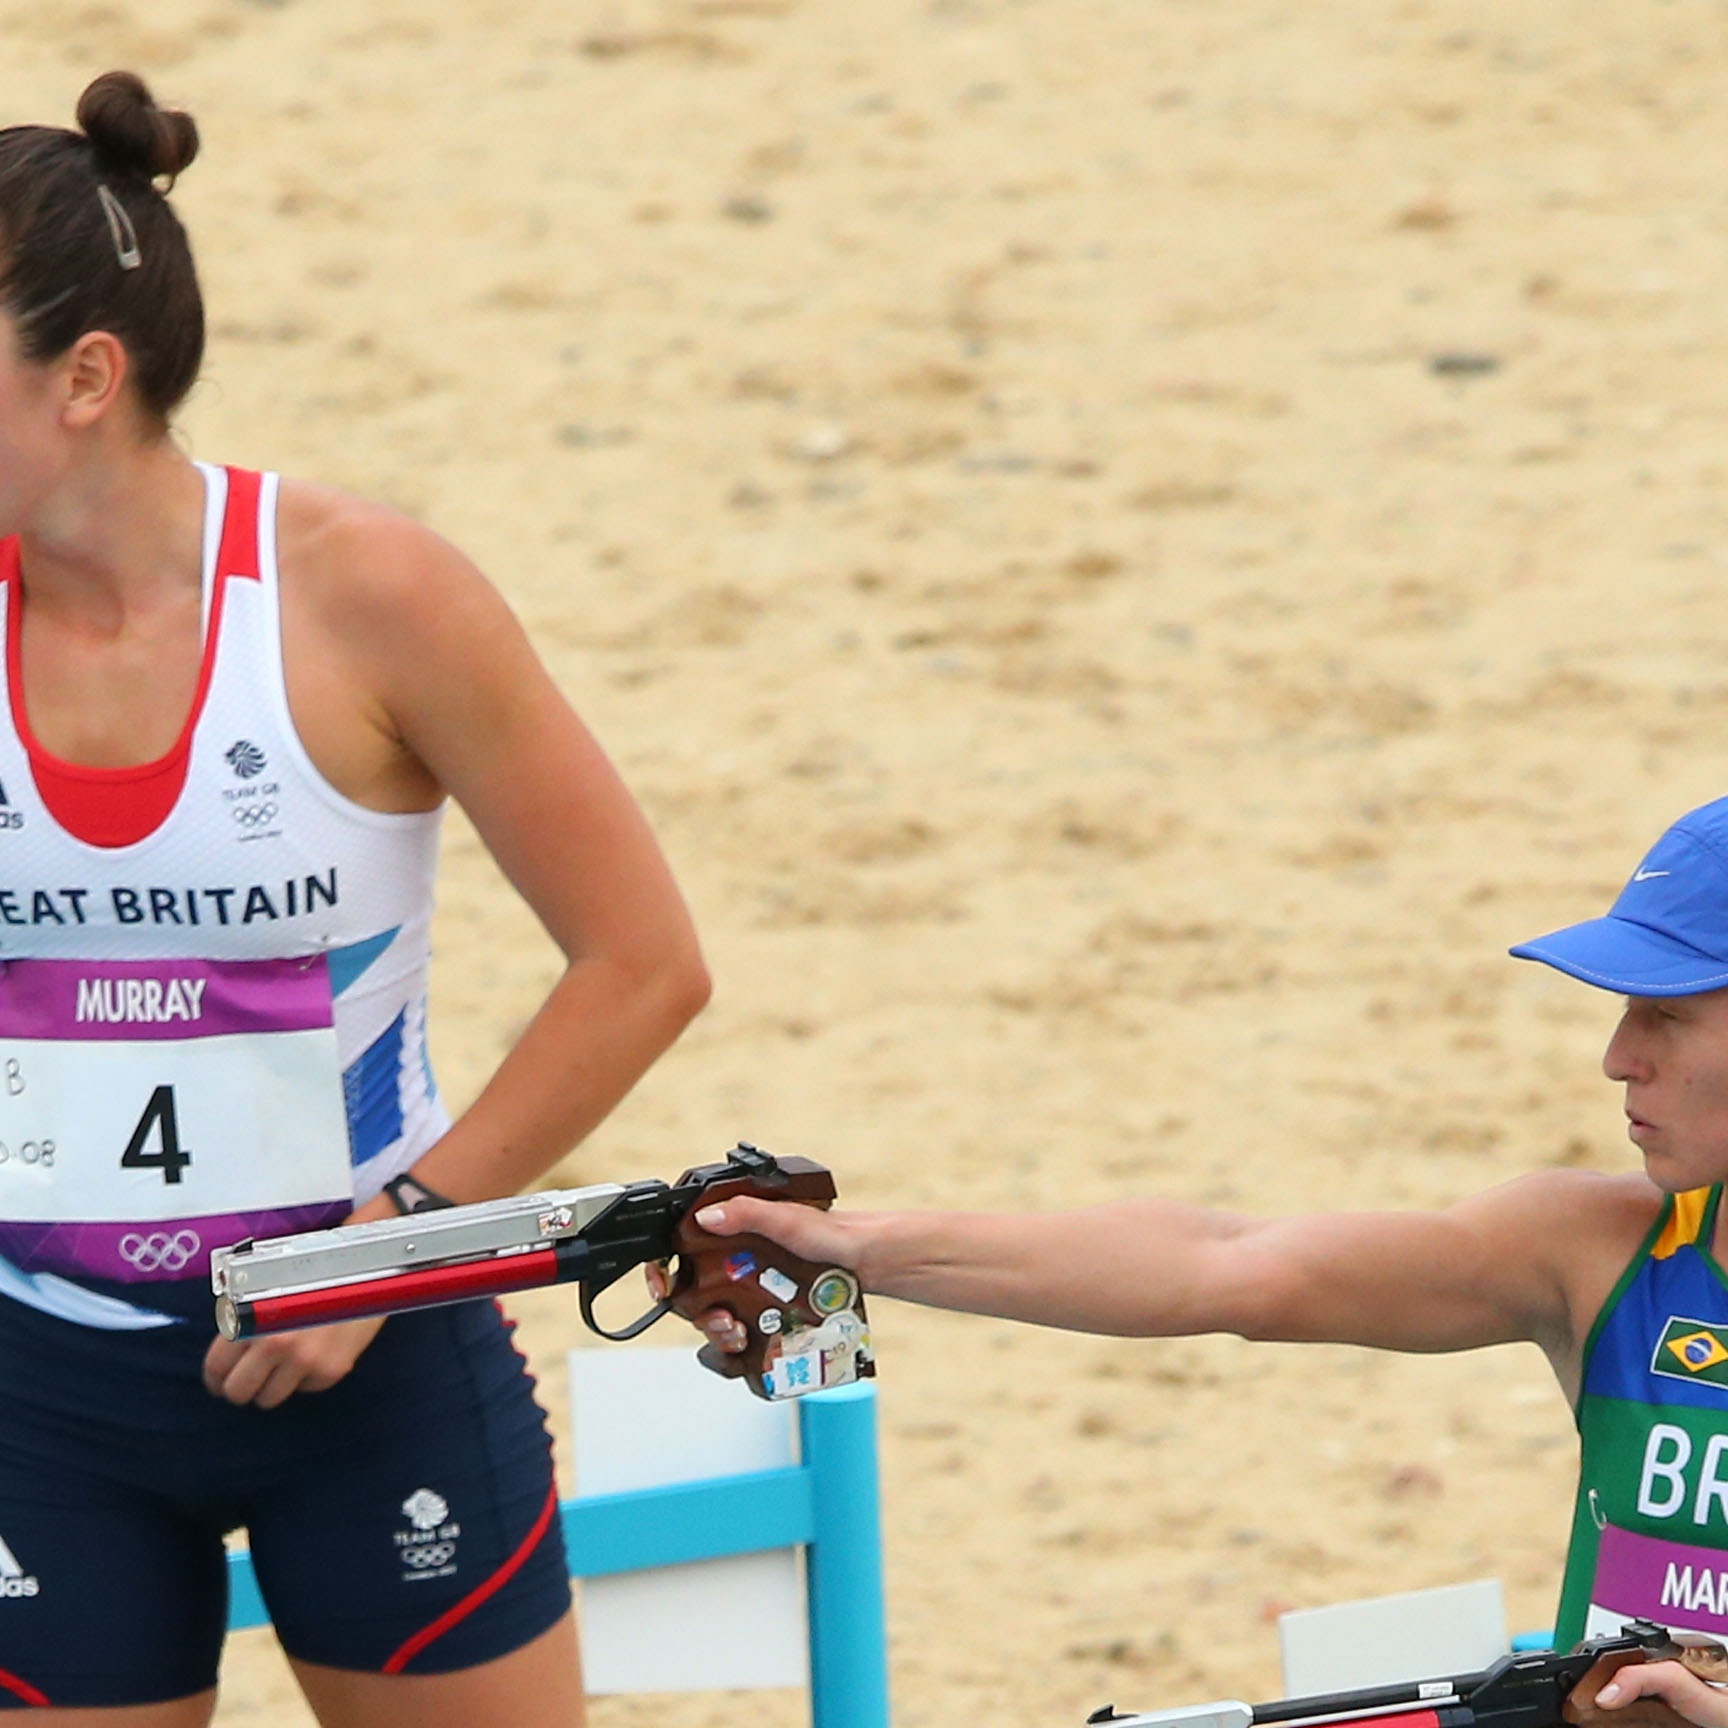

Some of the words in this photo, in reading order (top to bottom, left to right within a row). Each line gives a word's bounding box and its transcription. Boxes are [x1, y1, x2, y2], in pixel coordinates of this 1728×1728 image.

[111, 867, 339, 925] BRITAIN
[75, 978, 207, 1023] MURRAY
[5, 1057, 25, 1096] B
[121, 1084, 191, 1184] 4
